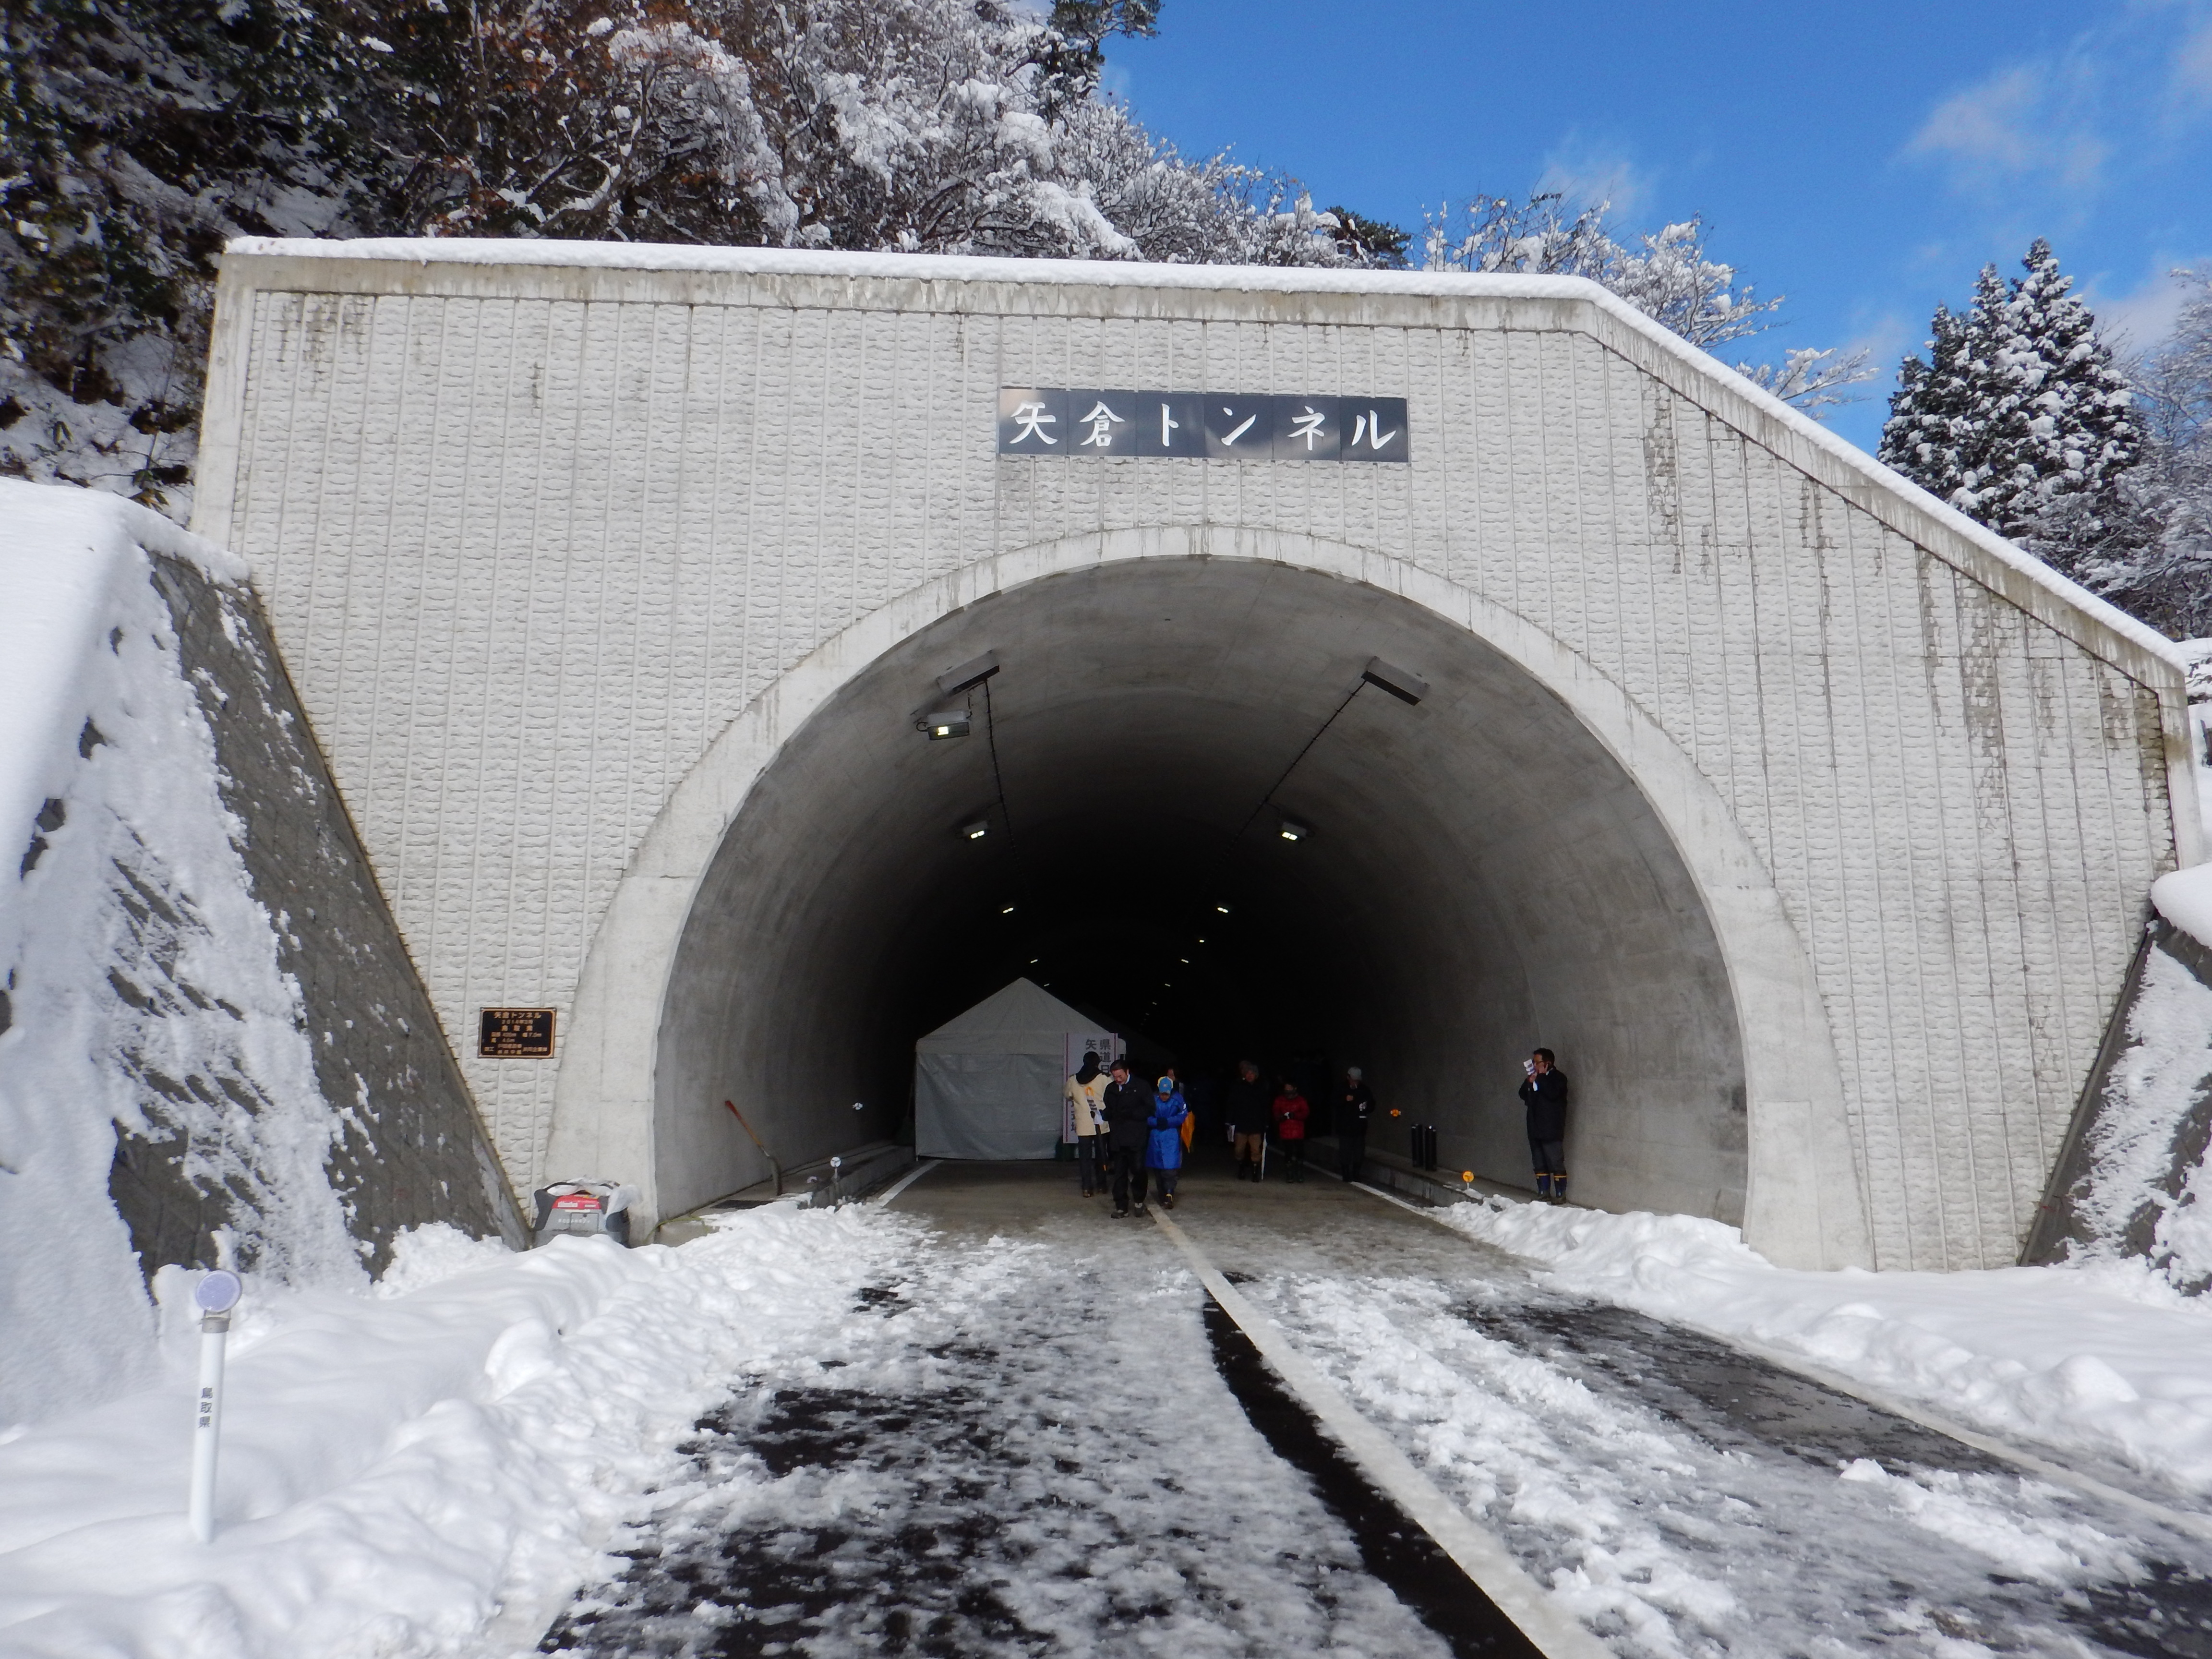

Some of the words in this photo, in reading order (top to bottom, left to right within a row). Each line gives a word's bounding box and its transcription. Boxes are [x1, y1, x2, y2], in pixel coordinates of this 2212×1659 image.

[1010, 400, 1397, 450] 矢倉トンネル
[198, 1387, 213, 1429] 鳥取県
